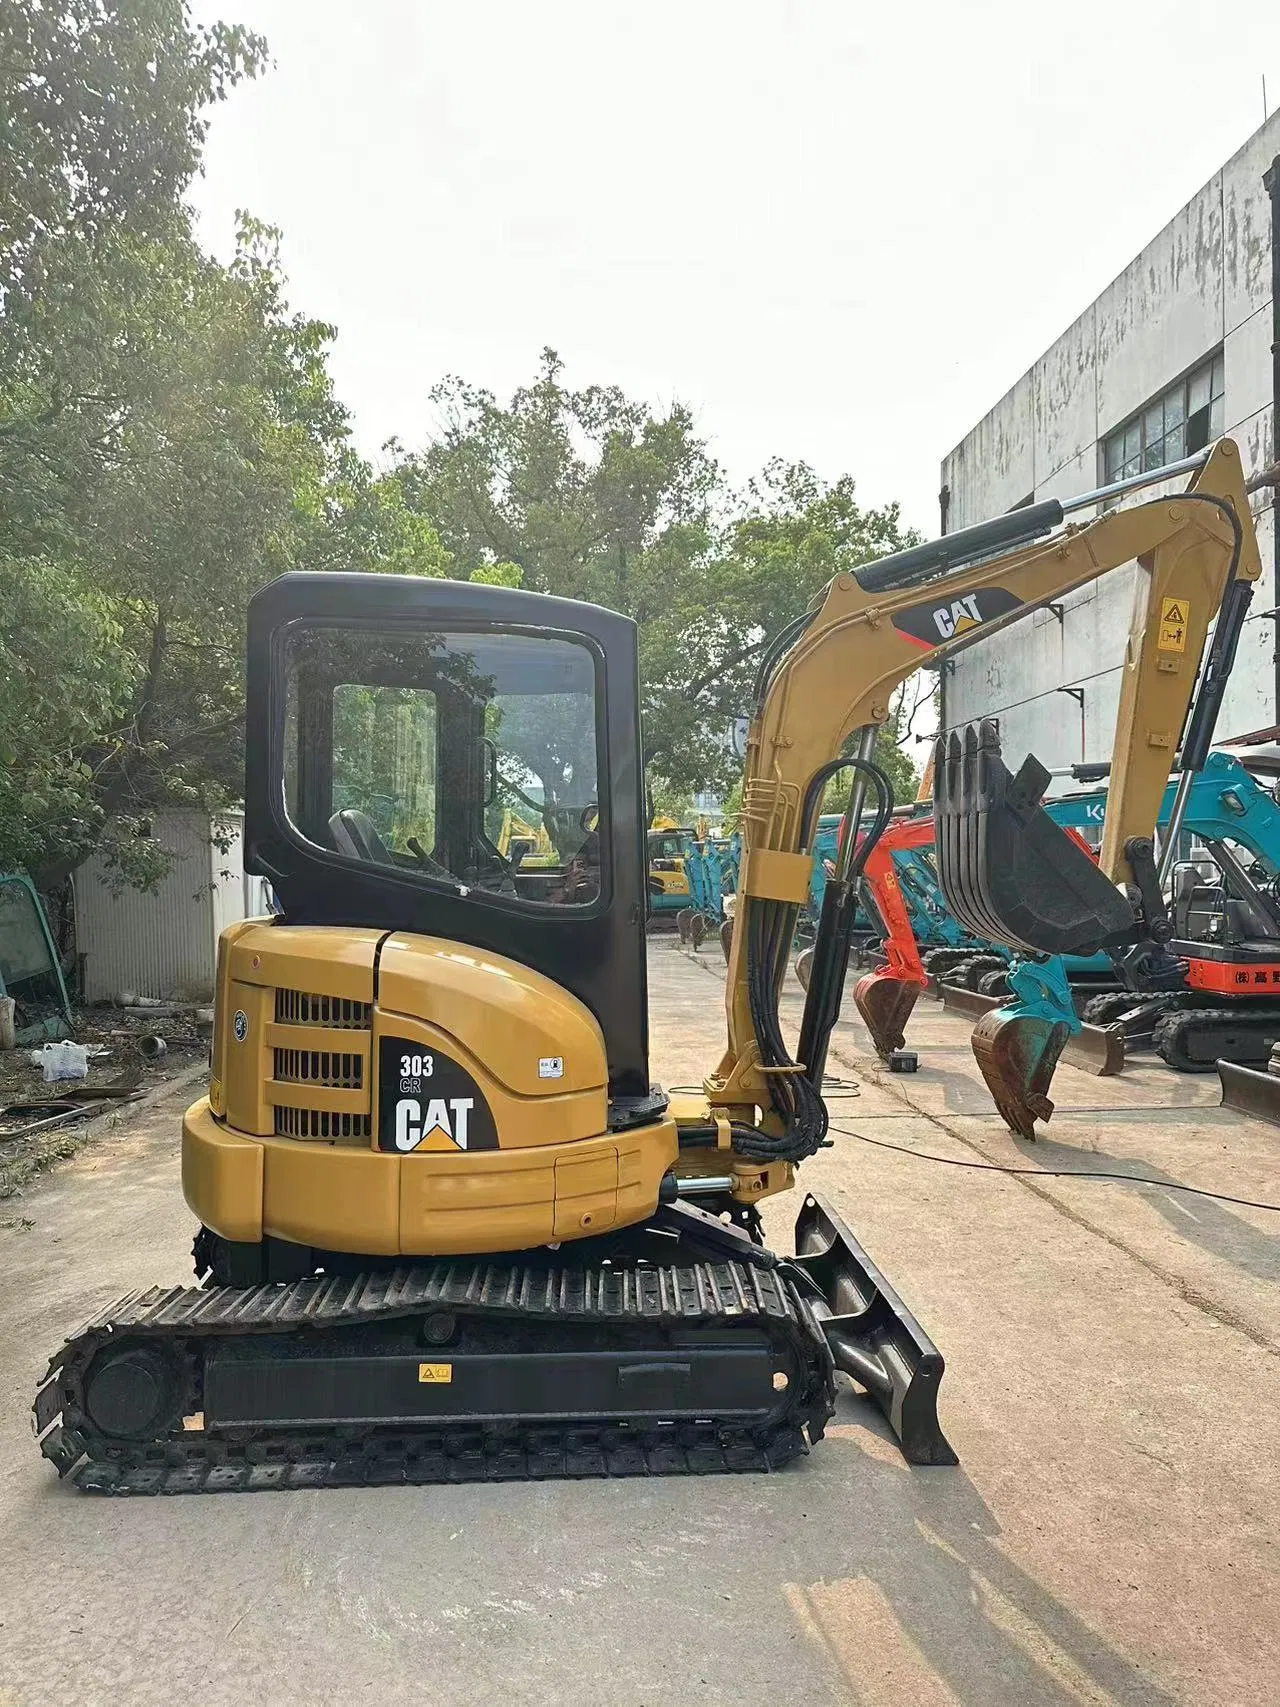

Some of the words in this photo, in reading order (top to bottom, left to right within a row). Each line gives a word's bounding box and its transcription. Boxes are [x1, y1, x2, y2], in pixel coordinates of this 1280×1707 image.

[933, 593, 983, 638] CAT
[400, 1055, 433, 1077] 303
[400, 1078, 421, 1093] CR
[396, 1098, 474, 1151] CAT
